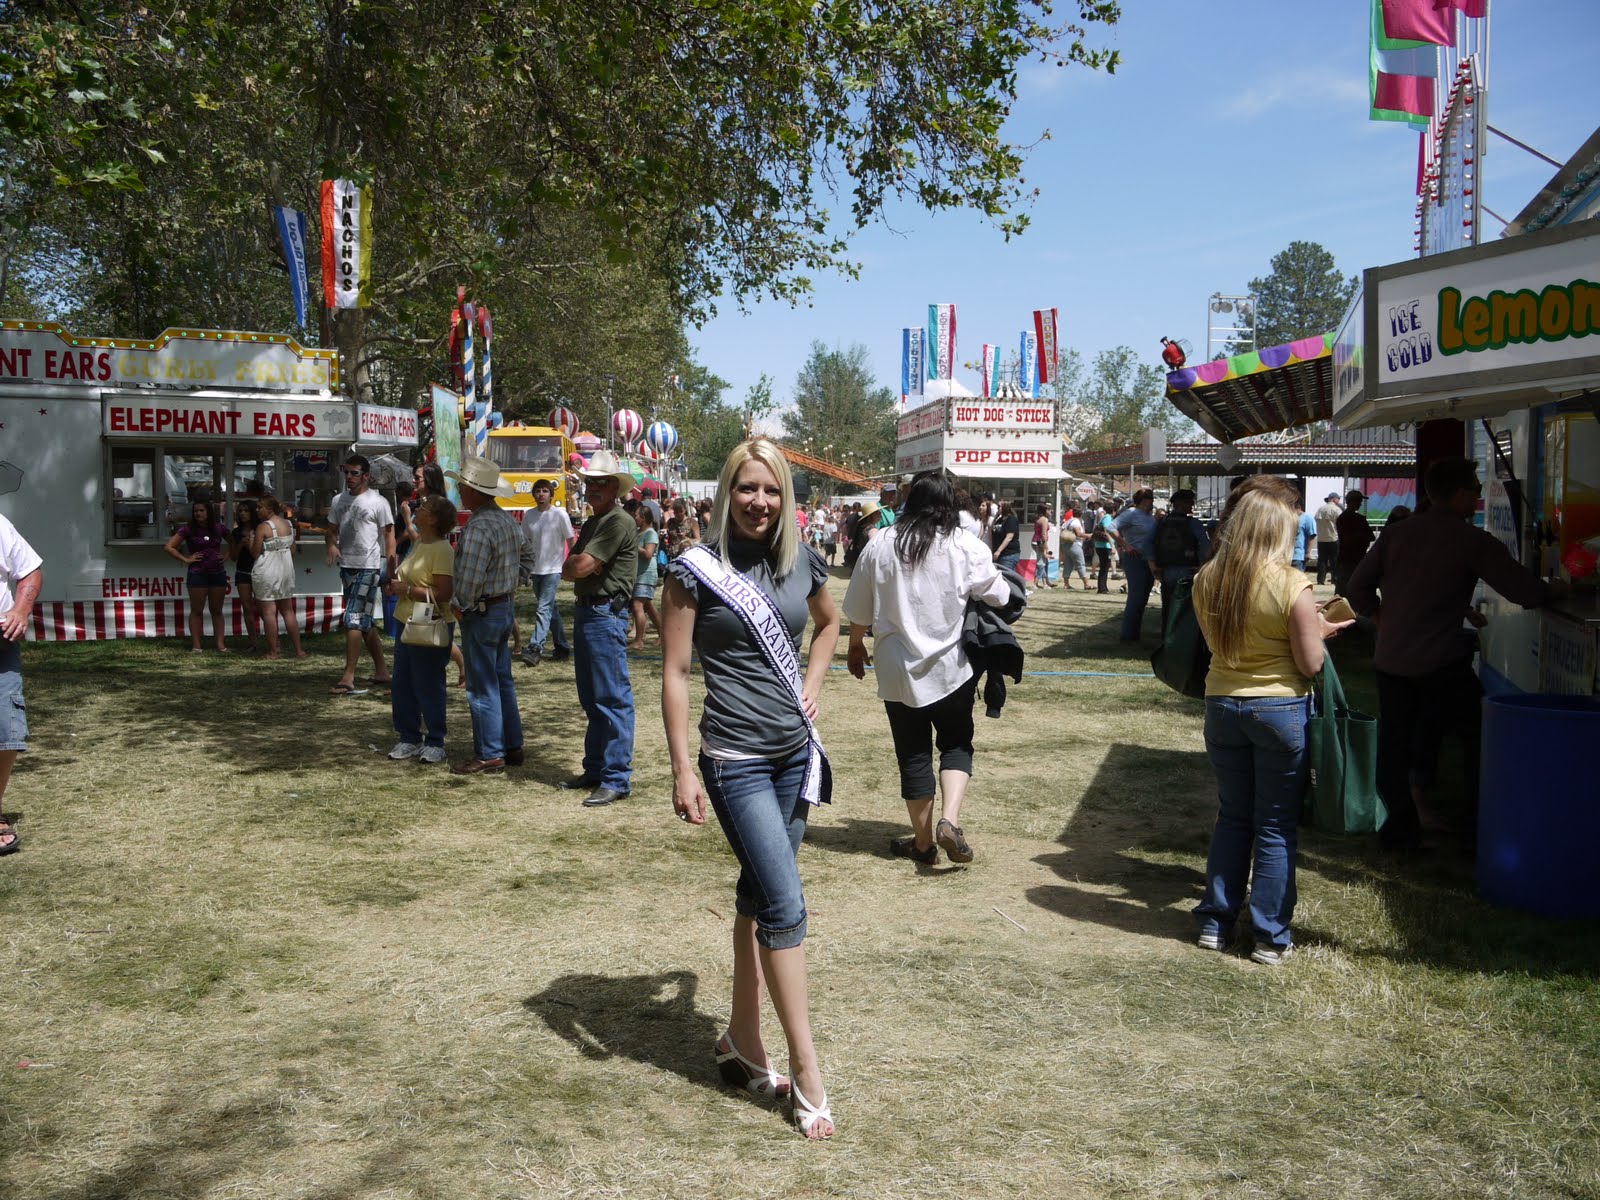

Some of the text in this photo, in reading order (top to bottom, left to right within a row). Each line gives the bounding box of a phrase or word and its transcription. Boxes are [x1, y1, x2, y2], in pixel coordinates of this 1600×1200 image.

[288, 221, 304, 260] COLD
[341, 195, 353, 292] NACHOS
[939, 313, 948, 347] COTTON
[1388, 299, 1422, 337] ICE
[45, 350, 111, 381] EARS
[1386, 331, 1433, 372] COLD
[236, 360, 328, 384] FRIES
[110, 407, 316, 438] ELEPHANT EARS
[361, 412, 415, 437] ELEPHANT EARS
[956, 407, 980, 421] HOT
[983, 408, 1004, 421] DOG
[1015, 408, 1051, 423] STICK
[955, 450, 1050, 463] POP CORN
[102, 577, 184, 598] ELEPHANT
[718, 573, 799, 685] MRS. NAMPA
